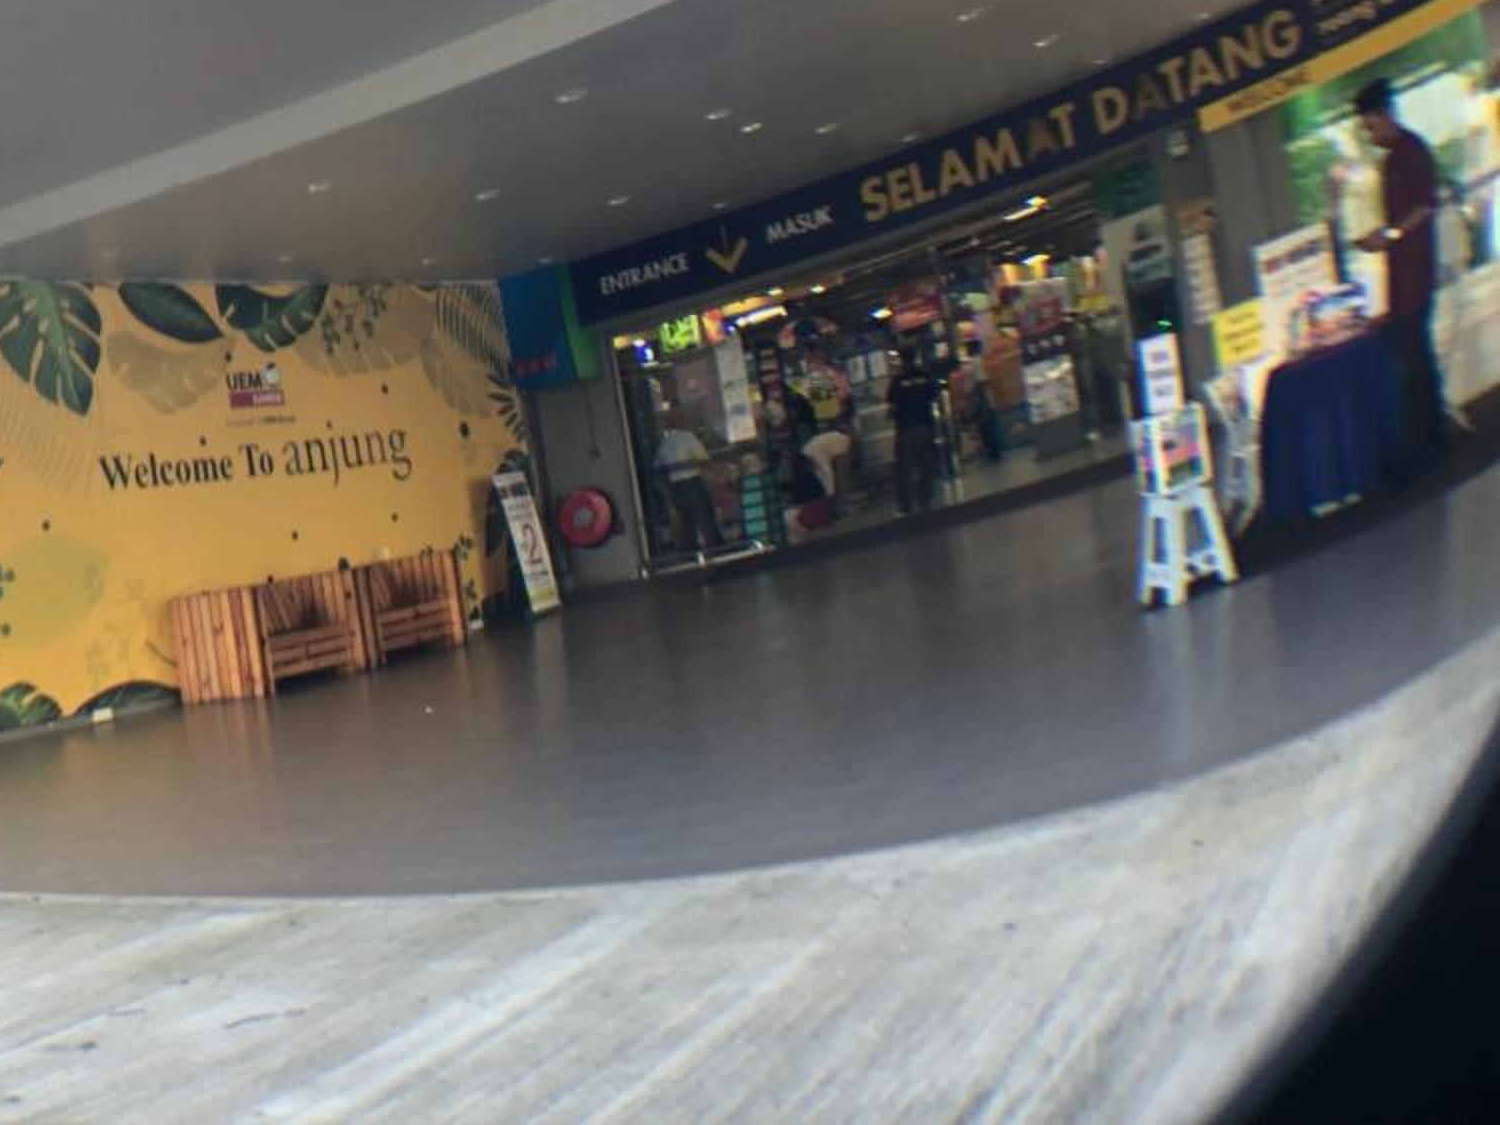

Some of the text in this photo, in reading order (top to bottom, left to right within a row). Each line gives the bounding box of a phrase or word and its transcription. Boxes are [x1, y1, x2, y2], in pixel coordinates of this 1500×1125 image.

[860, 9, 1301, 222] SELAMAT DATANG
[767, 205, 834, 244] MASUK
[599, 252, 690, 295] ENTRANCE
[226, 371, 263, 390] UEM
[99, 422, 413, 491] Welcome To anjung
